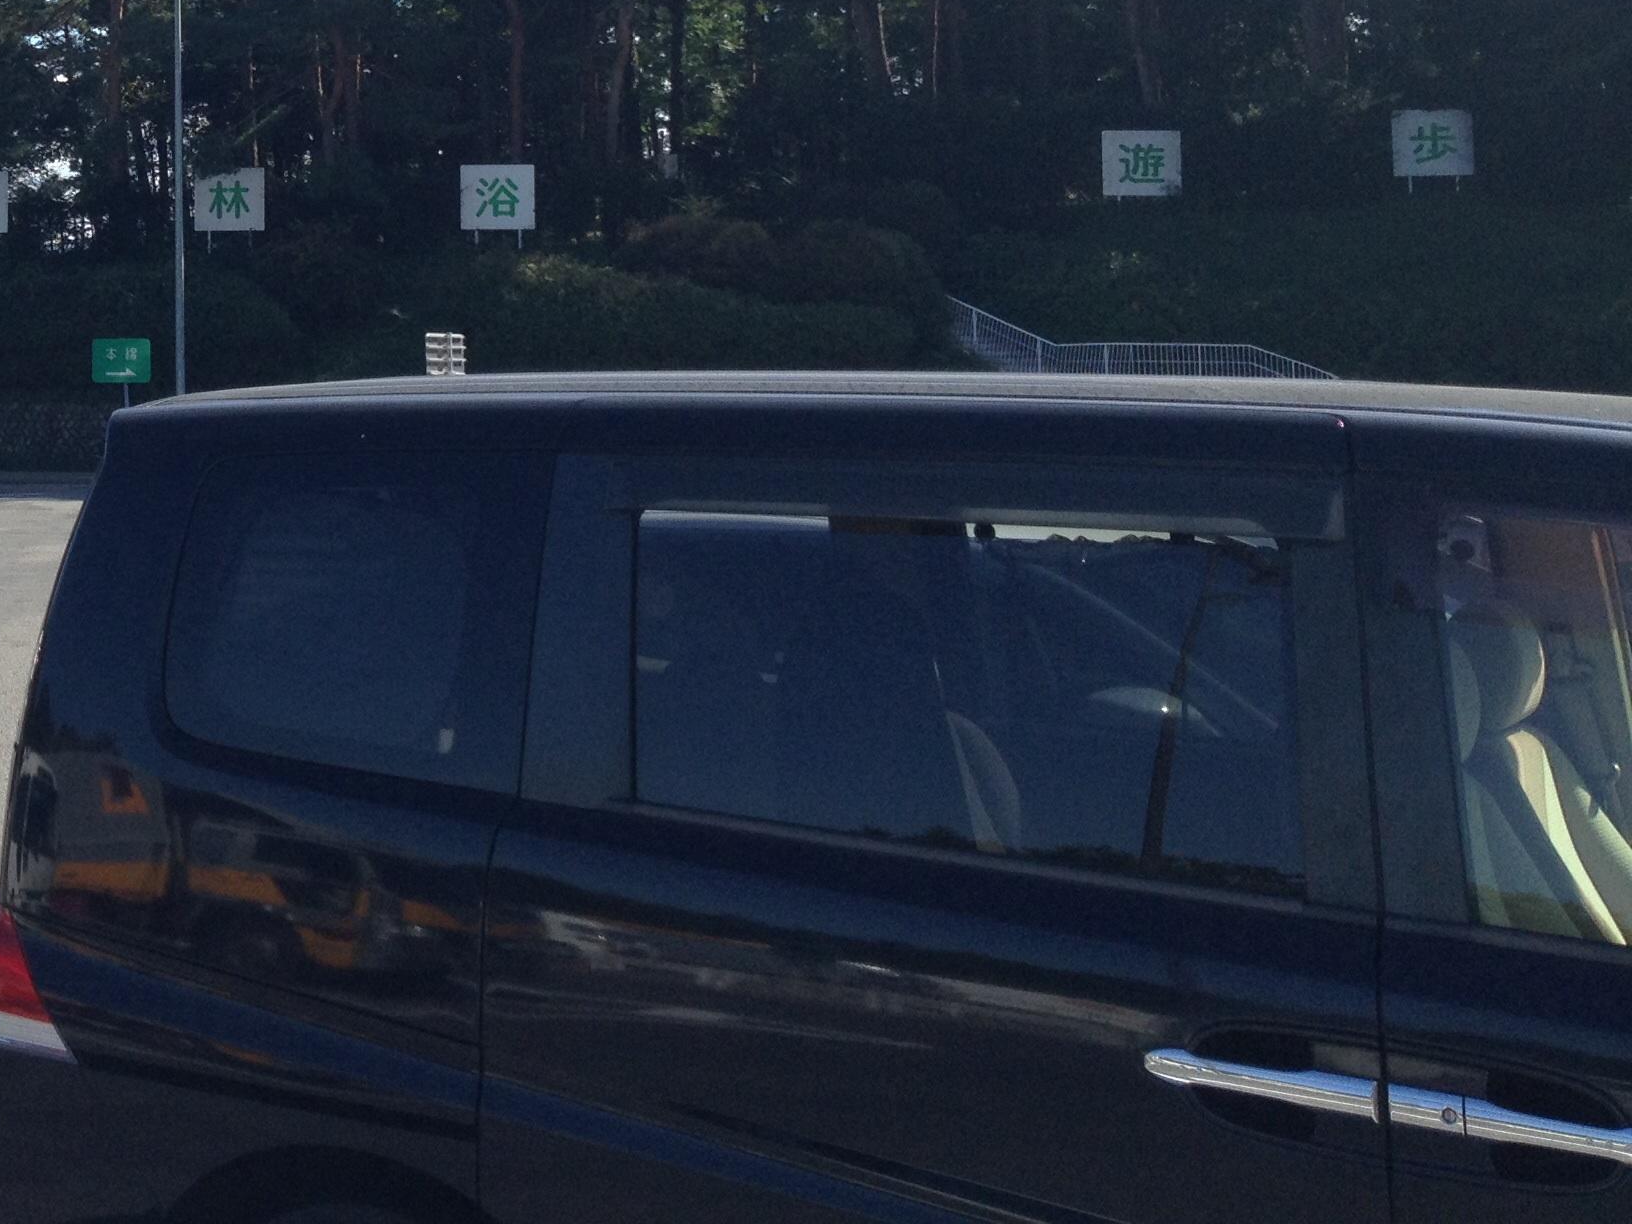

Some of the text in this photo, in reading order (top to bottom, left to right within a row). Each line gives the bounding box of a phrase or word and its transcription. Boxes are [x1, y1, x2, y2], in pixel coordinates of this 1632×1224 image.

[1118, 122, 1458, 184] 遊 歩
[208, 180, 250, 219] 林
[475, 177, 520, 218] 浴
